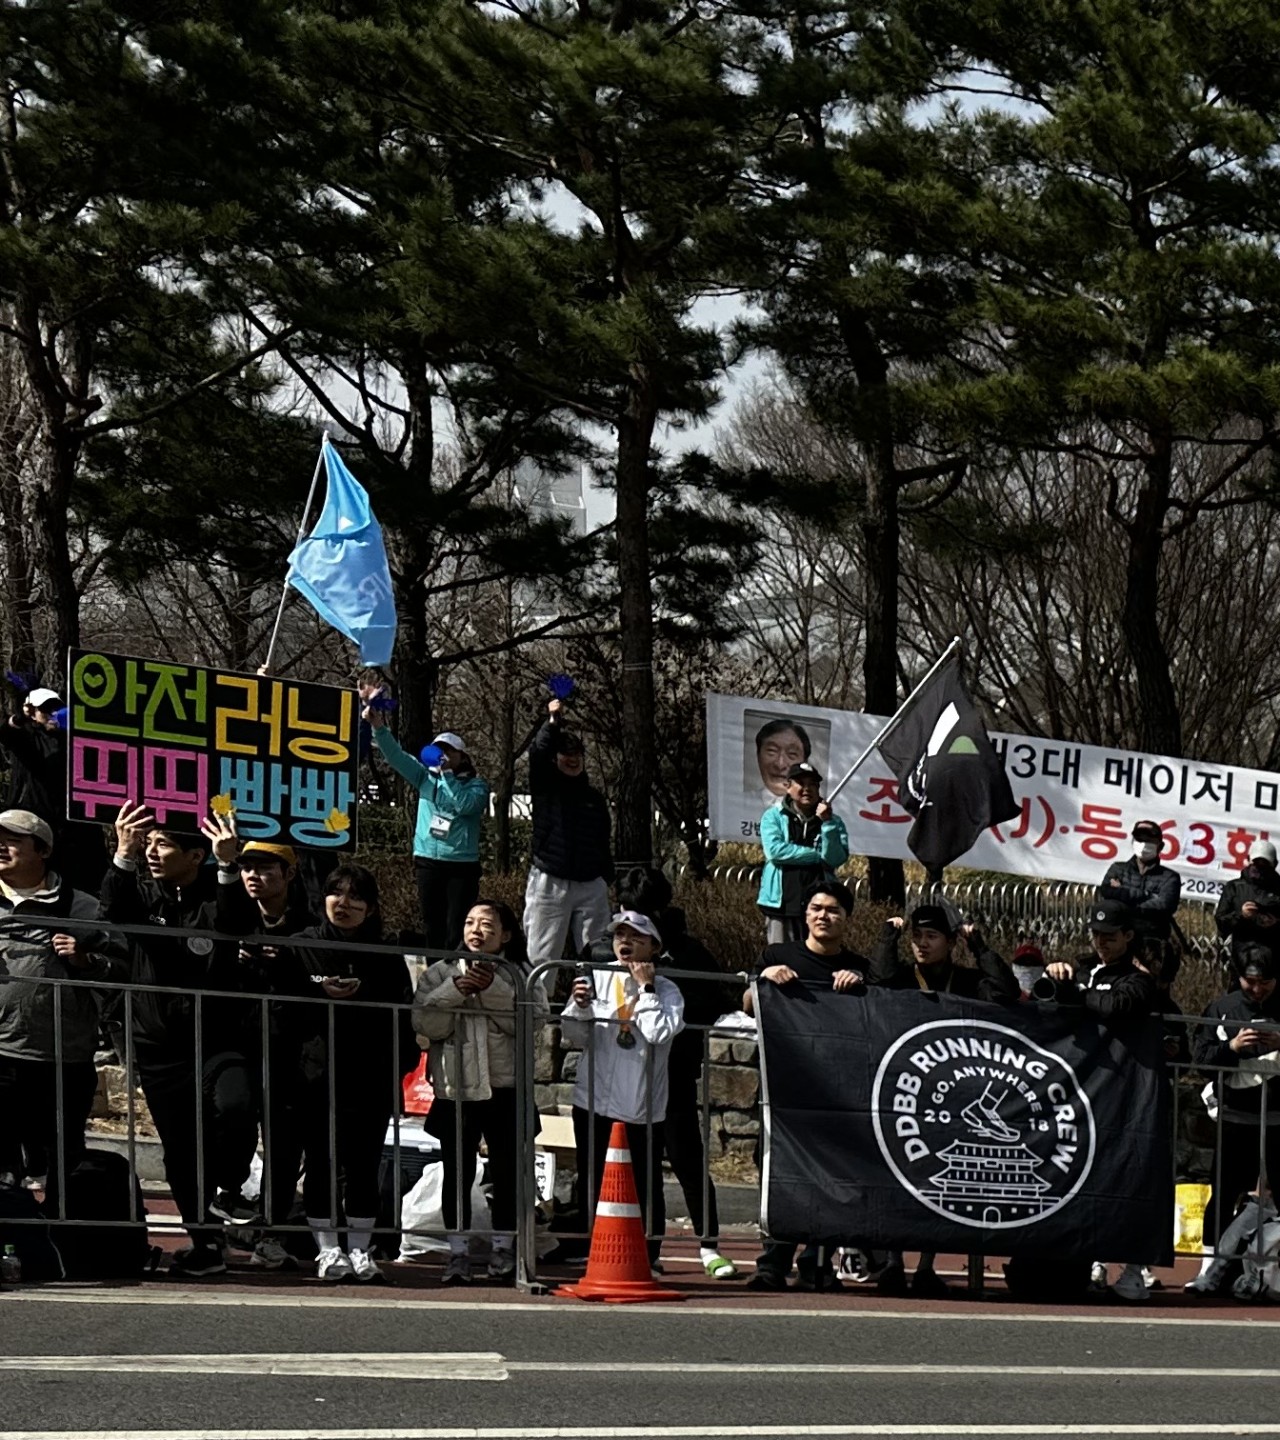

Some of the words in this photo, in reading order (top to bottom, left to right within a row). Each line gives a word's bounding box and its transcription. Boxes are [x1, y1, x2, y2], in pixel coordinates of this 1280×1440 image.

[72, 653, 207, 747] 안전
[215, 674, 352, 764] 러닝
[72, 736, 208, 828] 뛰뛰
[219, 756, 356, 847] 빵빵
[1104, 758, 1233, 812] 메이저
[909, 1037, 1049, 1080] RUNNING
[953, 1065, 1043, 1113] ANYWHERE
[893, 1071, 931, 1162] DDBB
[924, 1109, 951, 1124] 20
[1028, 1118, 1050, 1132] 18
[1046, 1082, 1078, 1174] CREW
